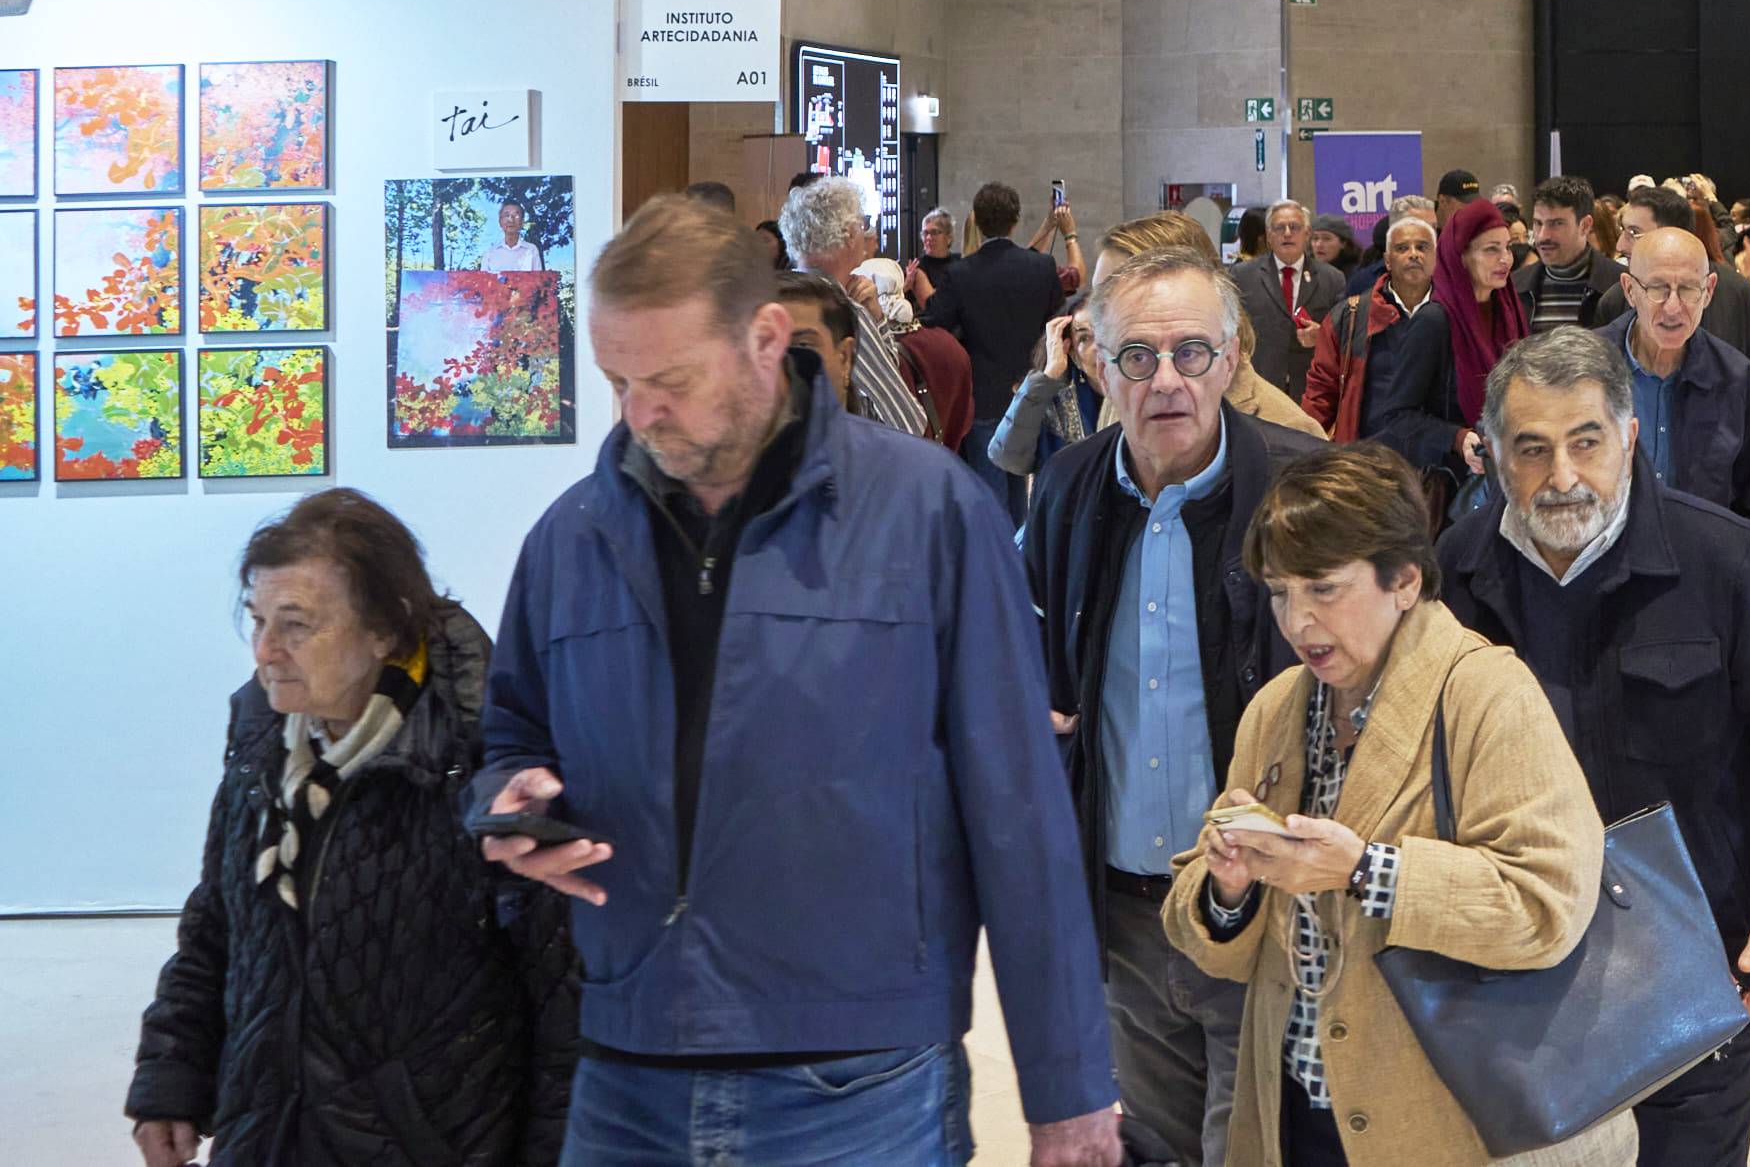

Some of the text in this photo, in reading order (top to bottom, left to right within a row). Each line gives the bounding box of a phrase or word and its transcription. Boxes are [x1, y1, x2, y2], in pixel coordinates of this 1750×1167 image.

[666, 12, 734, 25] INSTITUTO
[640, 30, 759, 42] ARTECIDADANIA
[627, 75, 659, 87] BRÉSIL
[737, 71, 767, 85] A01
[1341, 173, 1398, 214] art
